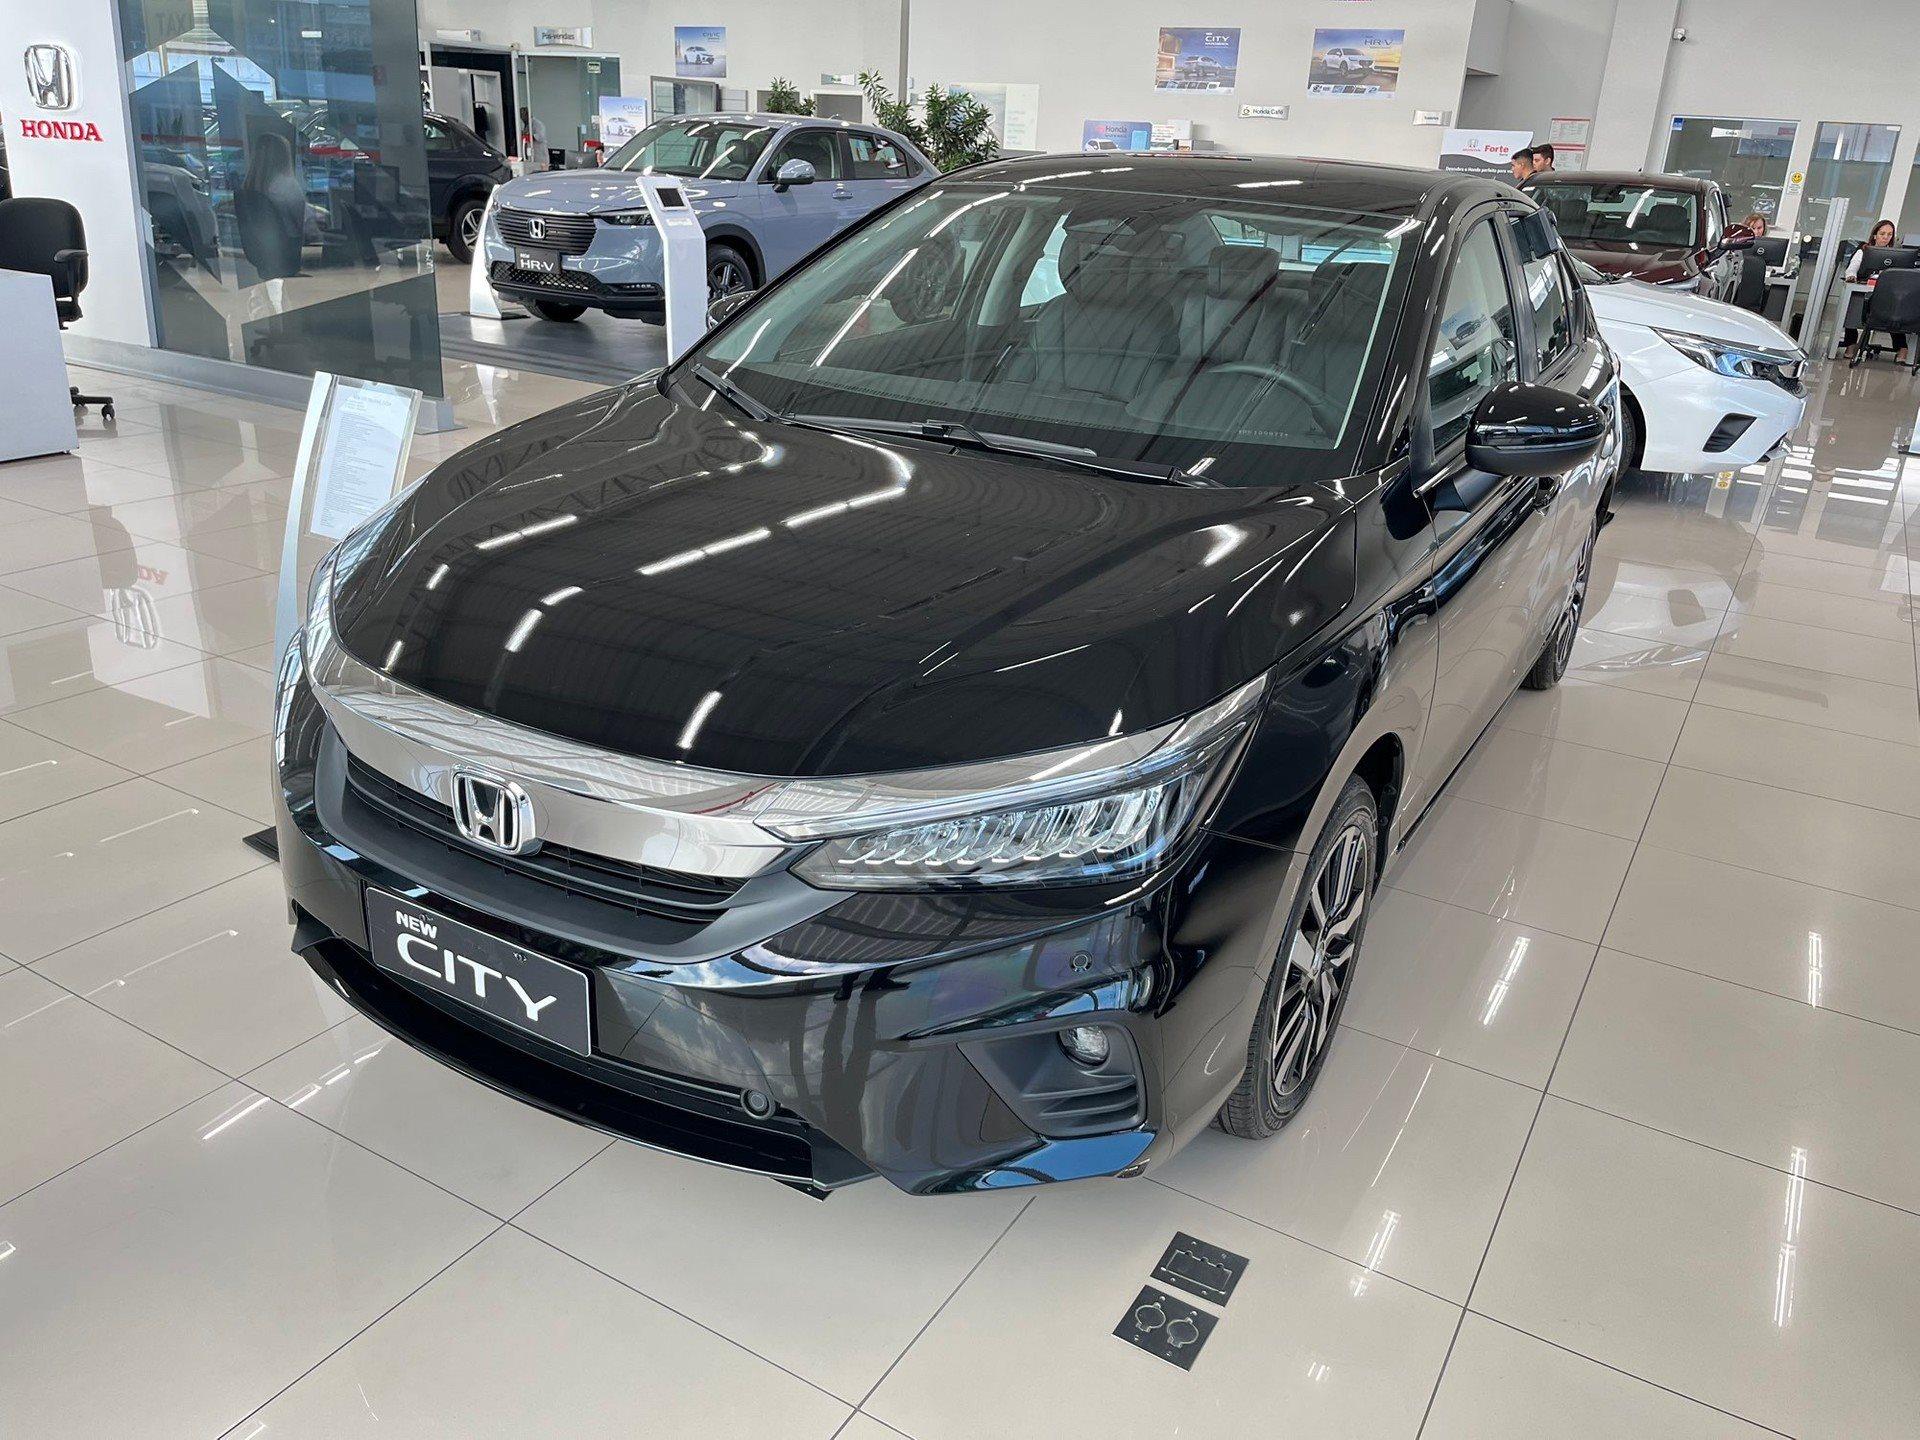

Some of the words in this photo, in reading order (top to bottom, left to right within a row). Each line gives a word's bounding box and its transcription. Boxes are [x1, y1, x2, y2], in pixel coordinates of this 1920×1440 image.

[20, 118, 104, 142] HONDA
[1484, 145, 1509, 153] Forte
[395, 910, 438, 940] NEW
[396, 932, 558, 1022] CITY
